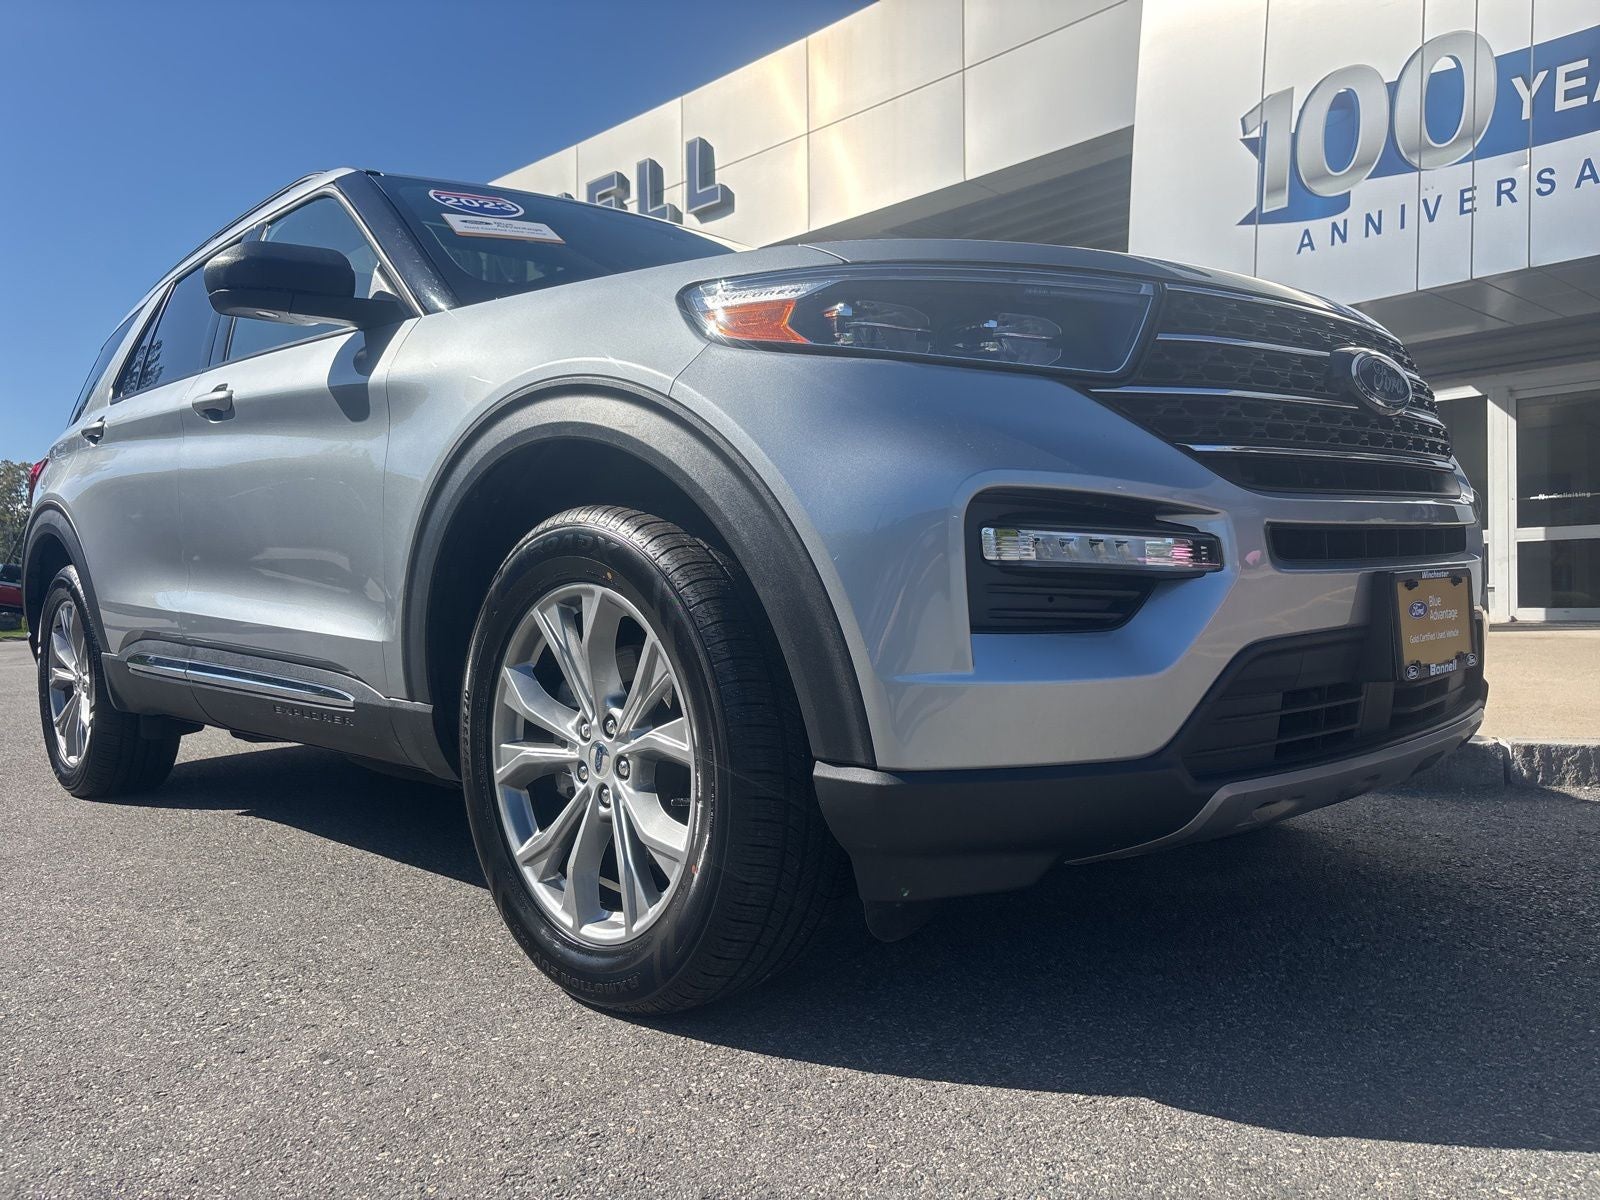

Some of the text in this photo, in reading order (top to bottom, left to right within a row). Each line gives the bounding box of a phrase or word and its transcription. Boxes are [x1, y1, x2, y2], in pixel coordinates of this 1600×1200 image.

[1239, 30, 1497, 213] 100
[440, 195, 518, 212] 2023
[1422, 571, 1449, 579] Winchester
[1429, 596, 1442, 607] Blue
[1411, 603, 1425, 617] Ford
[1430, 608, 1458, 621] Advantage
[1430, 660, 1457, 676] Bonnell
